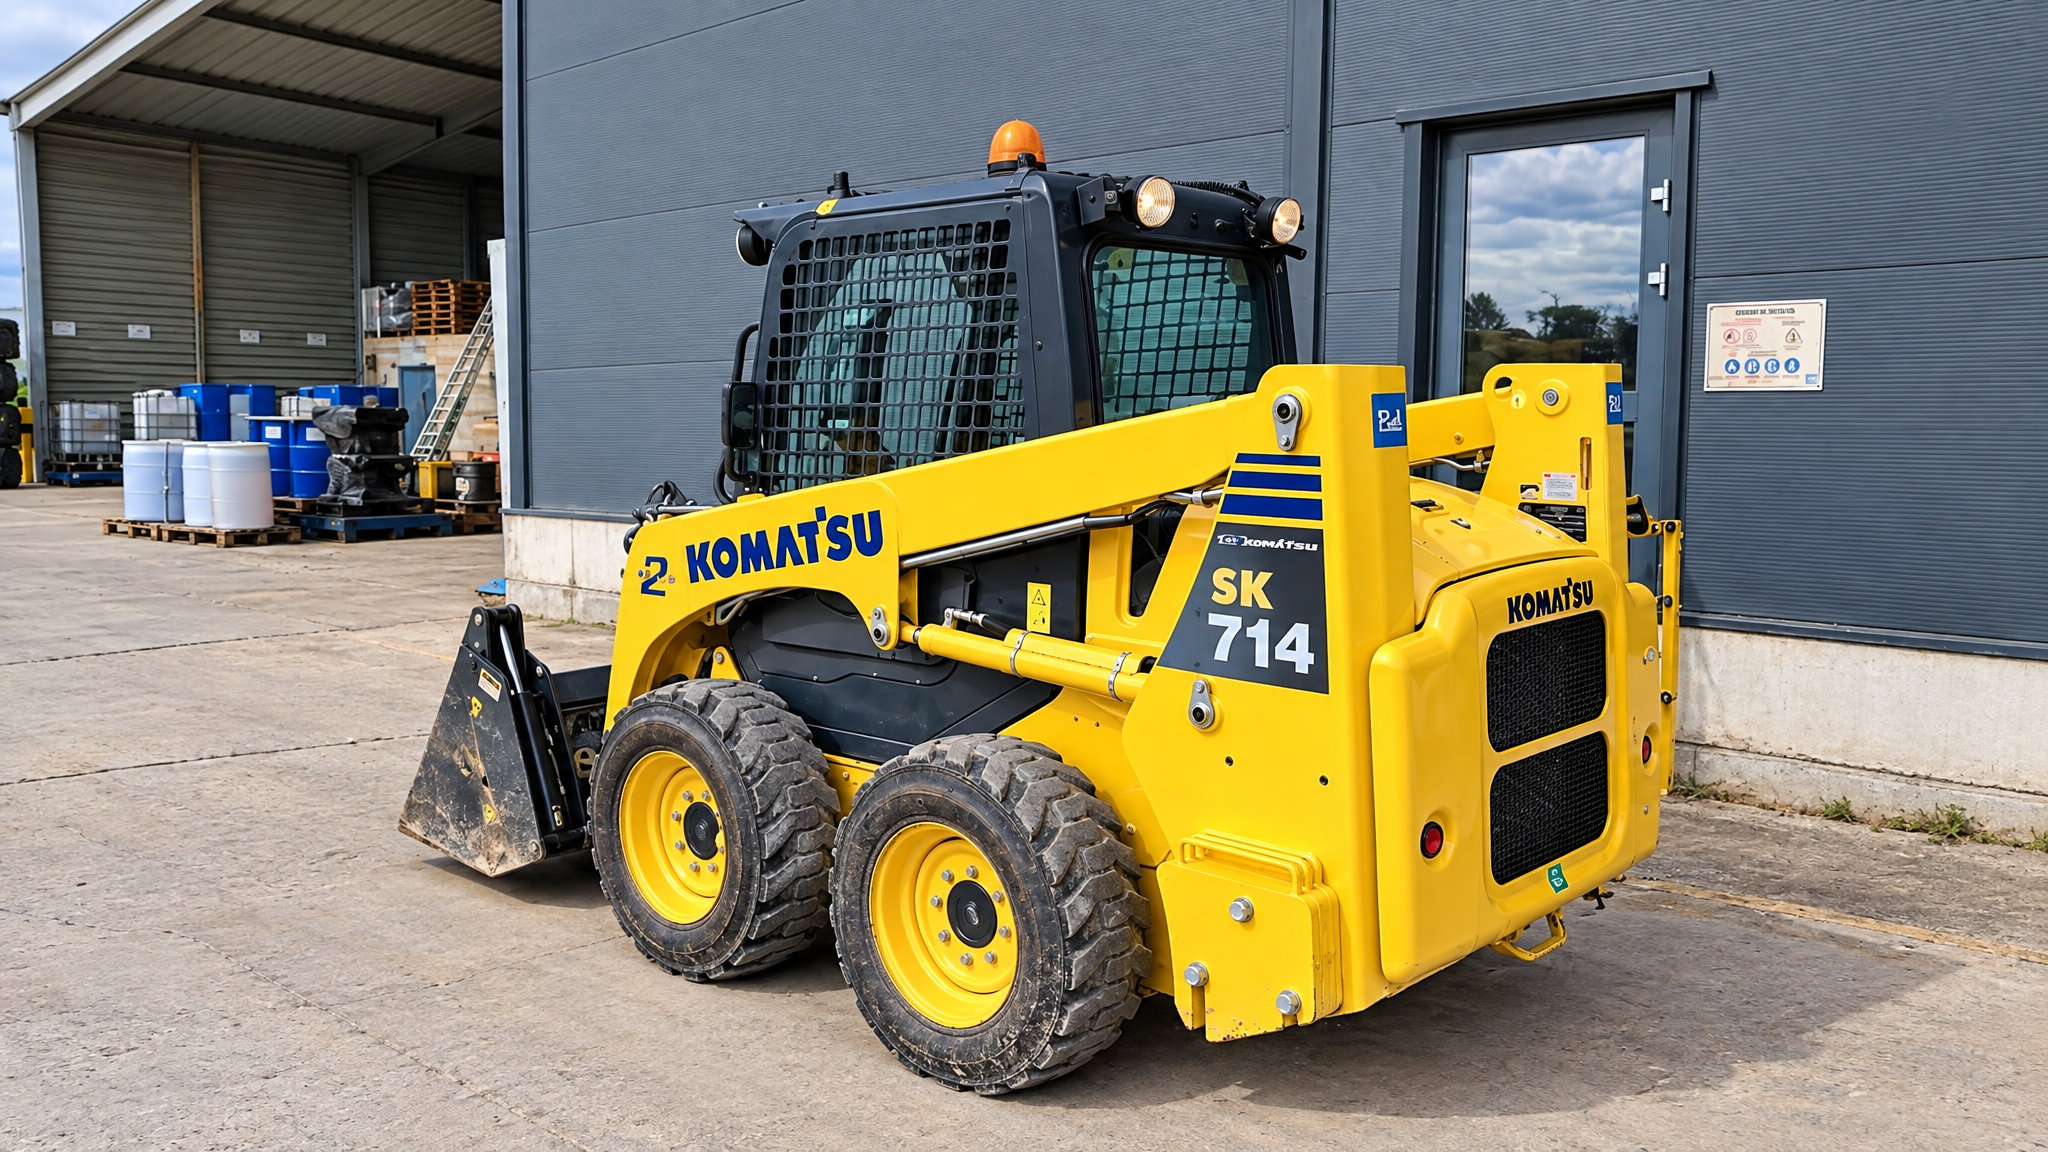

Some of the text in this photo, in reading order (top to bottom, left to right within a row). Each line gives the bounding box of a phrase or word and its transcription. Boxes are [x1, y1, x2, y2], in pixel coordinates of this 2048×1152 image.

[685, 506, 884, 584] KOMATSU
[1245, 538, 1319, 551] KOMATSU
[641, 556, 668, 597] 2
[1211, 567, 1274, 610] SK
[1506, 577, 1594, 625] KOMATSU
[1208, 612, 1315, 675] 714
